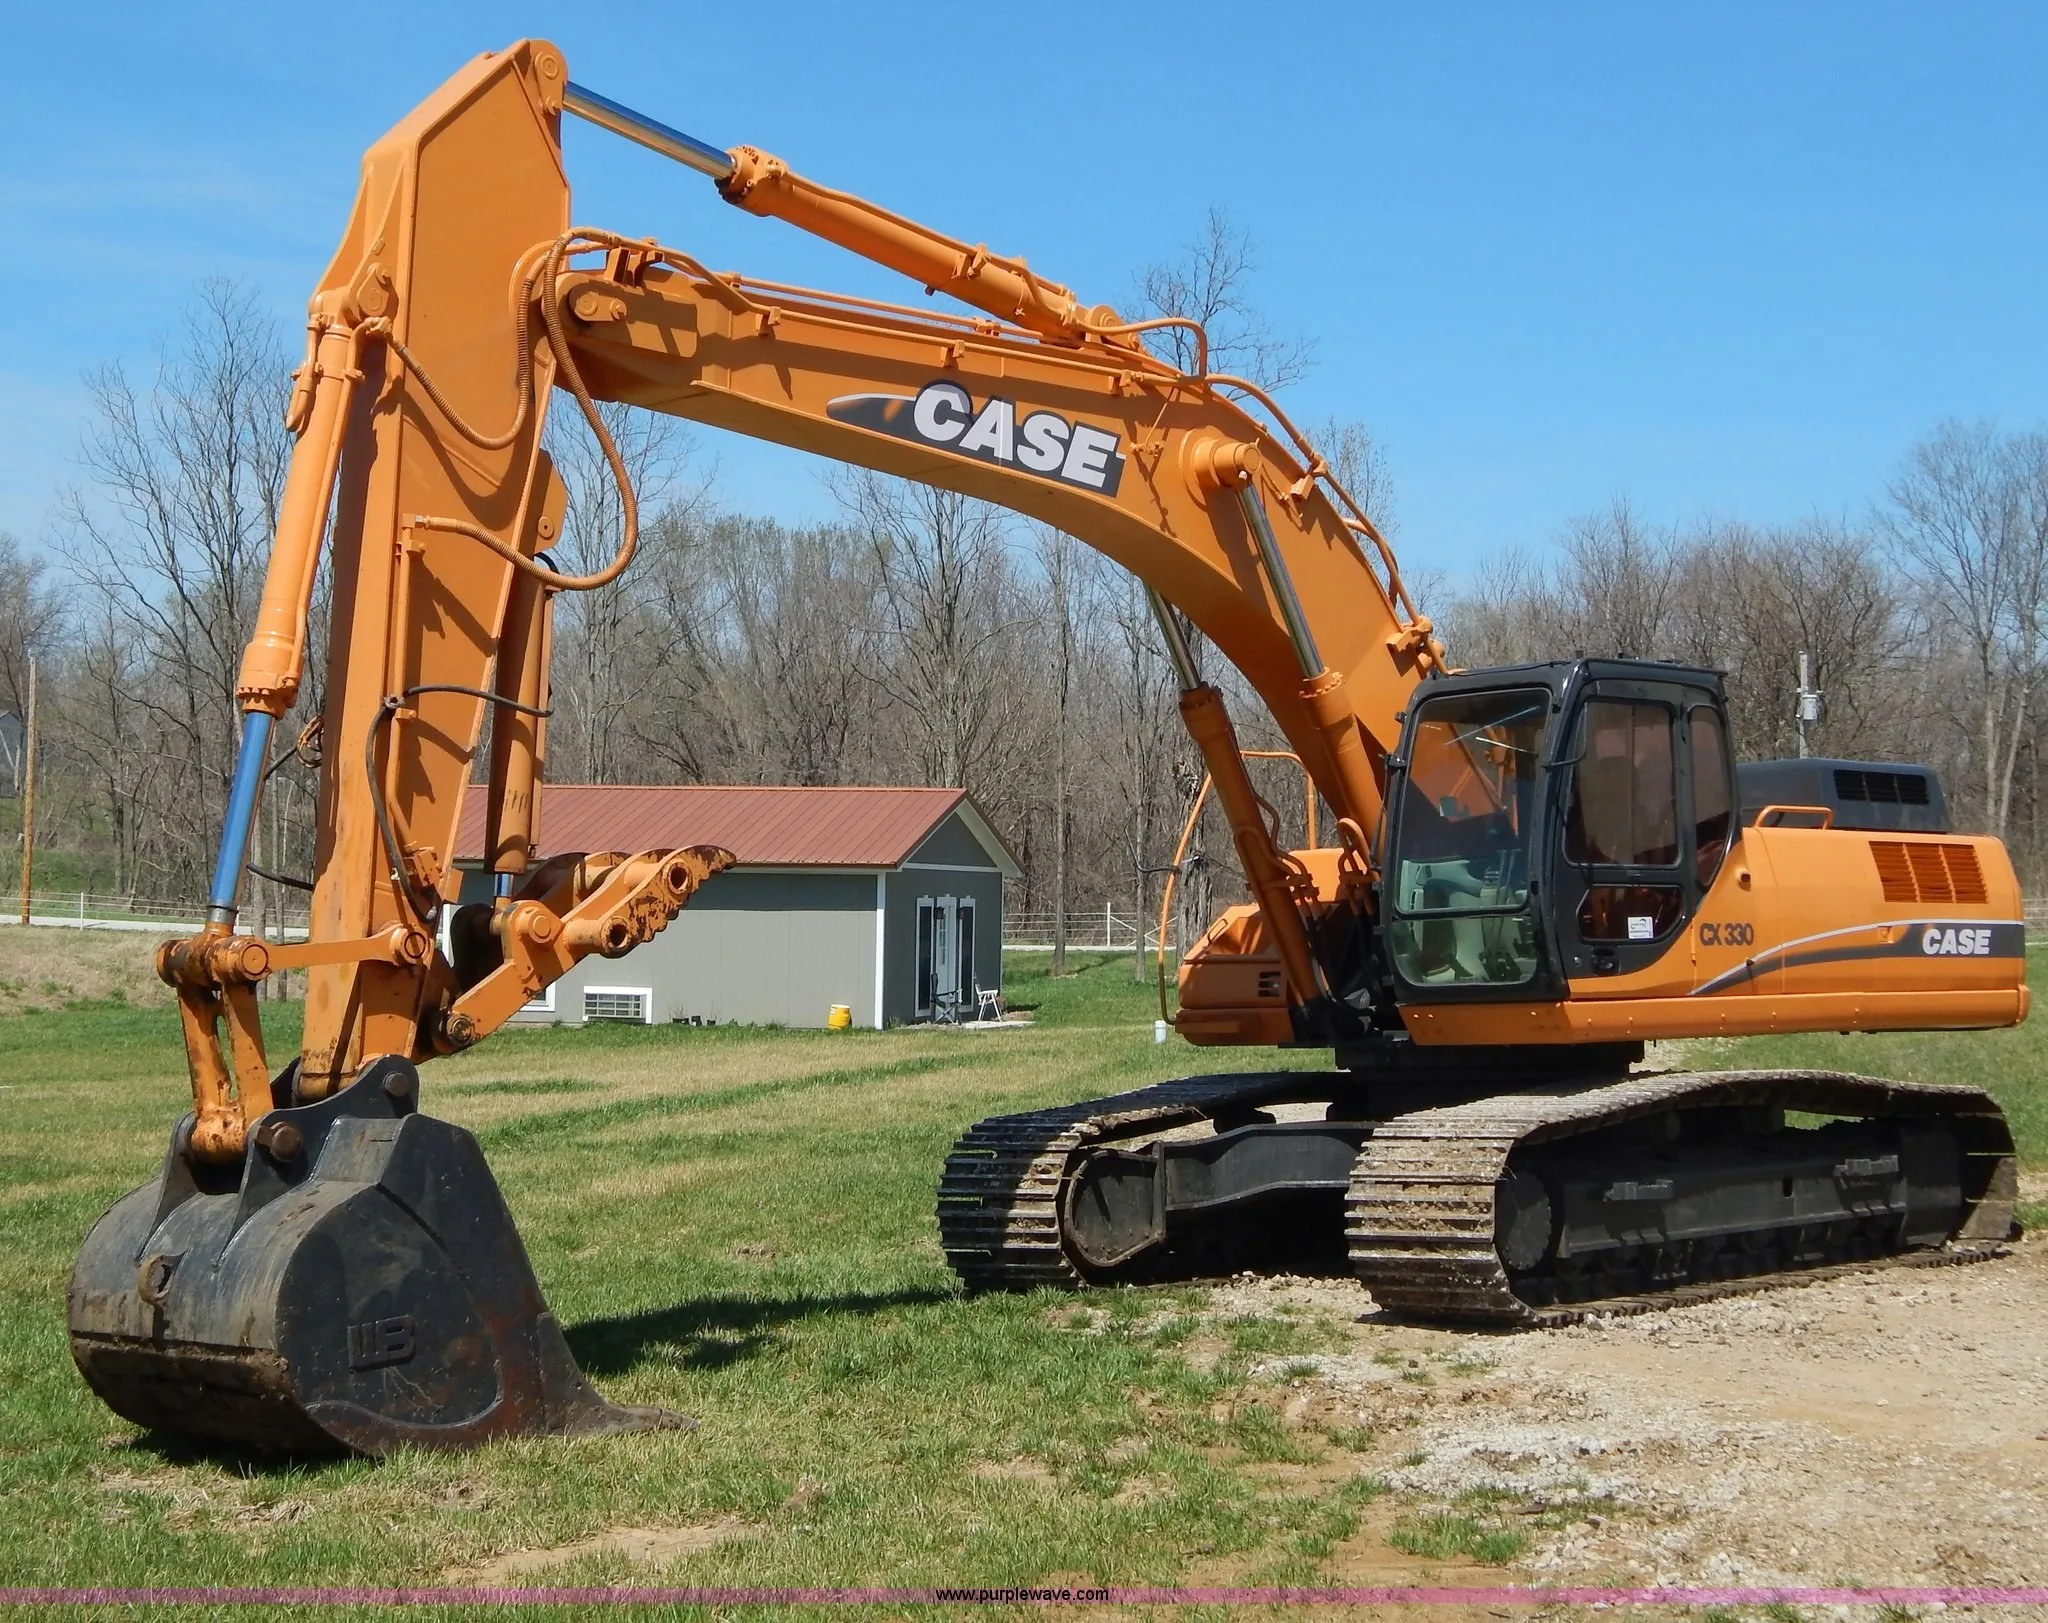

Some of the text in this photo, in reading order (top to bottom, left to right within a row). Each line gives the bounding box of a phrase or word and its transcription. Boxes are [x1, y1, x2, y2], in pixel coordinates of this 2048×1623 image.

[914, 383, 1118, 488] CASE
[1700, 922, 1754, 946] CX 330
[1922, 928, 1991, 955] CASE
